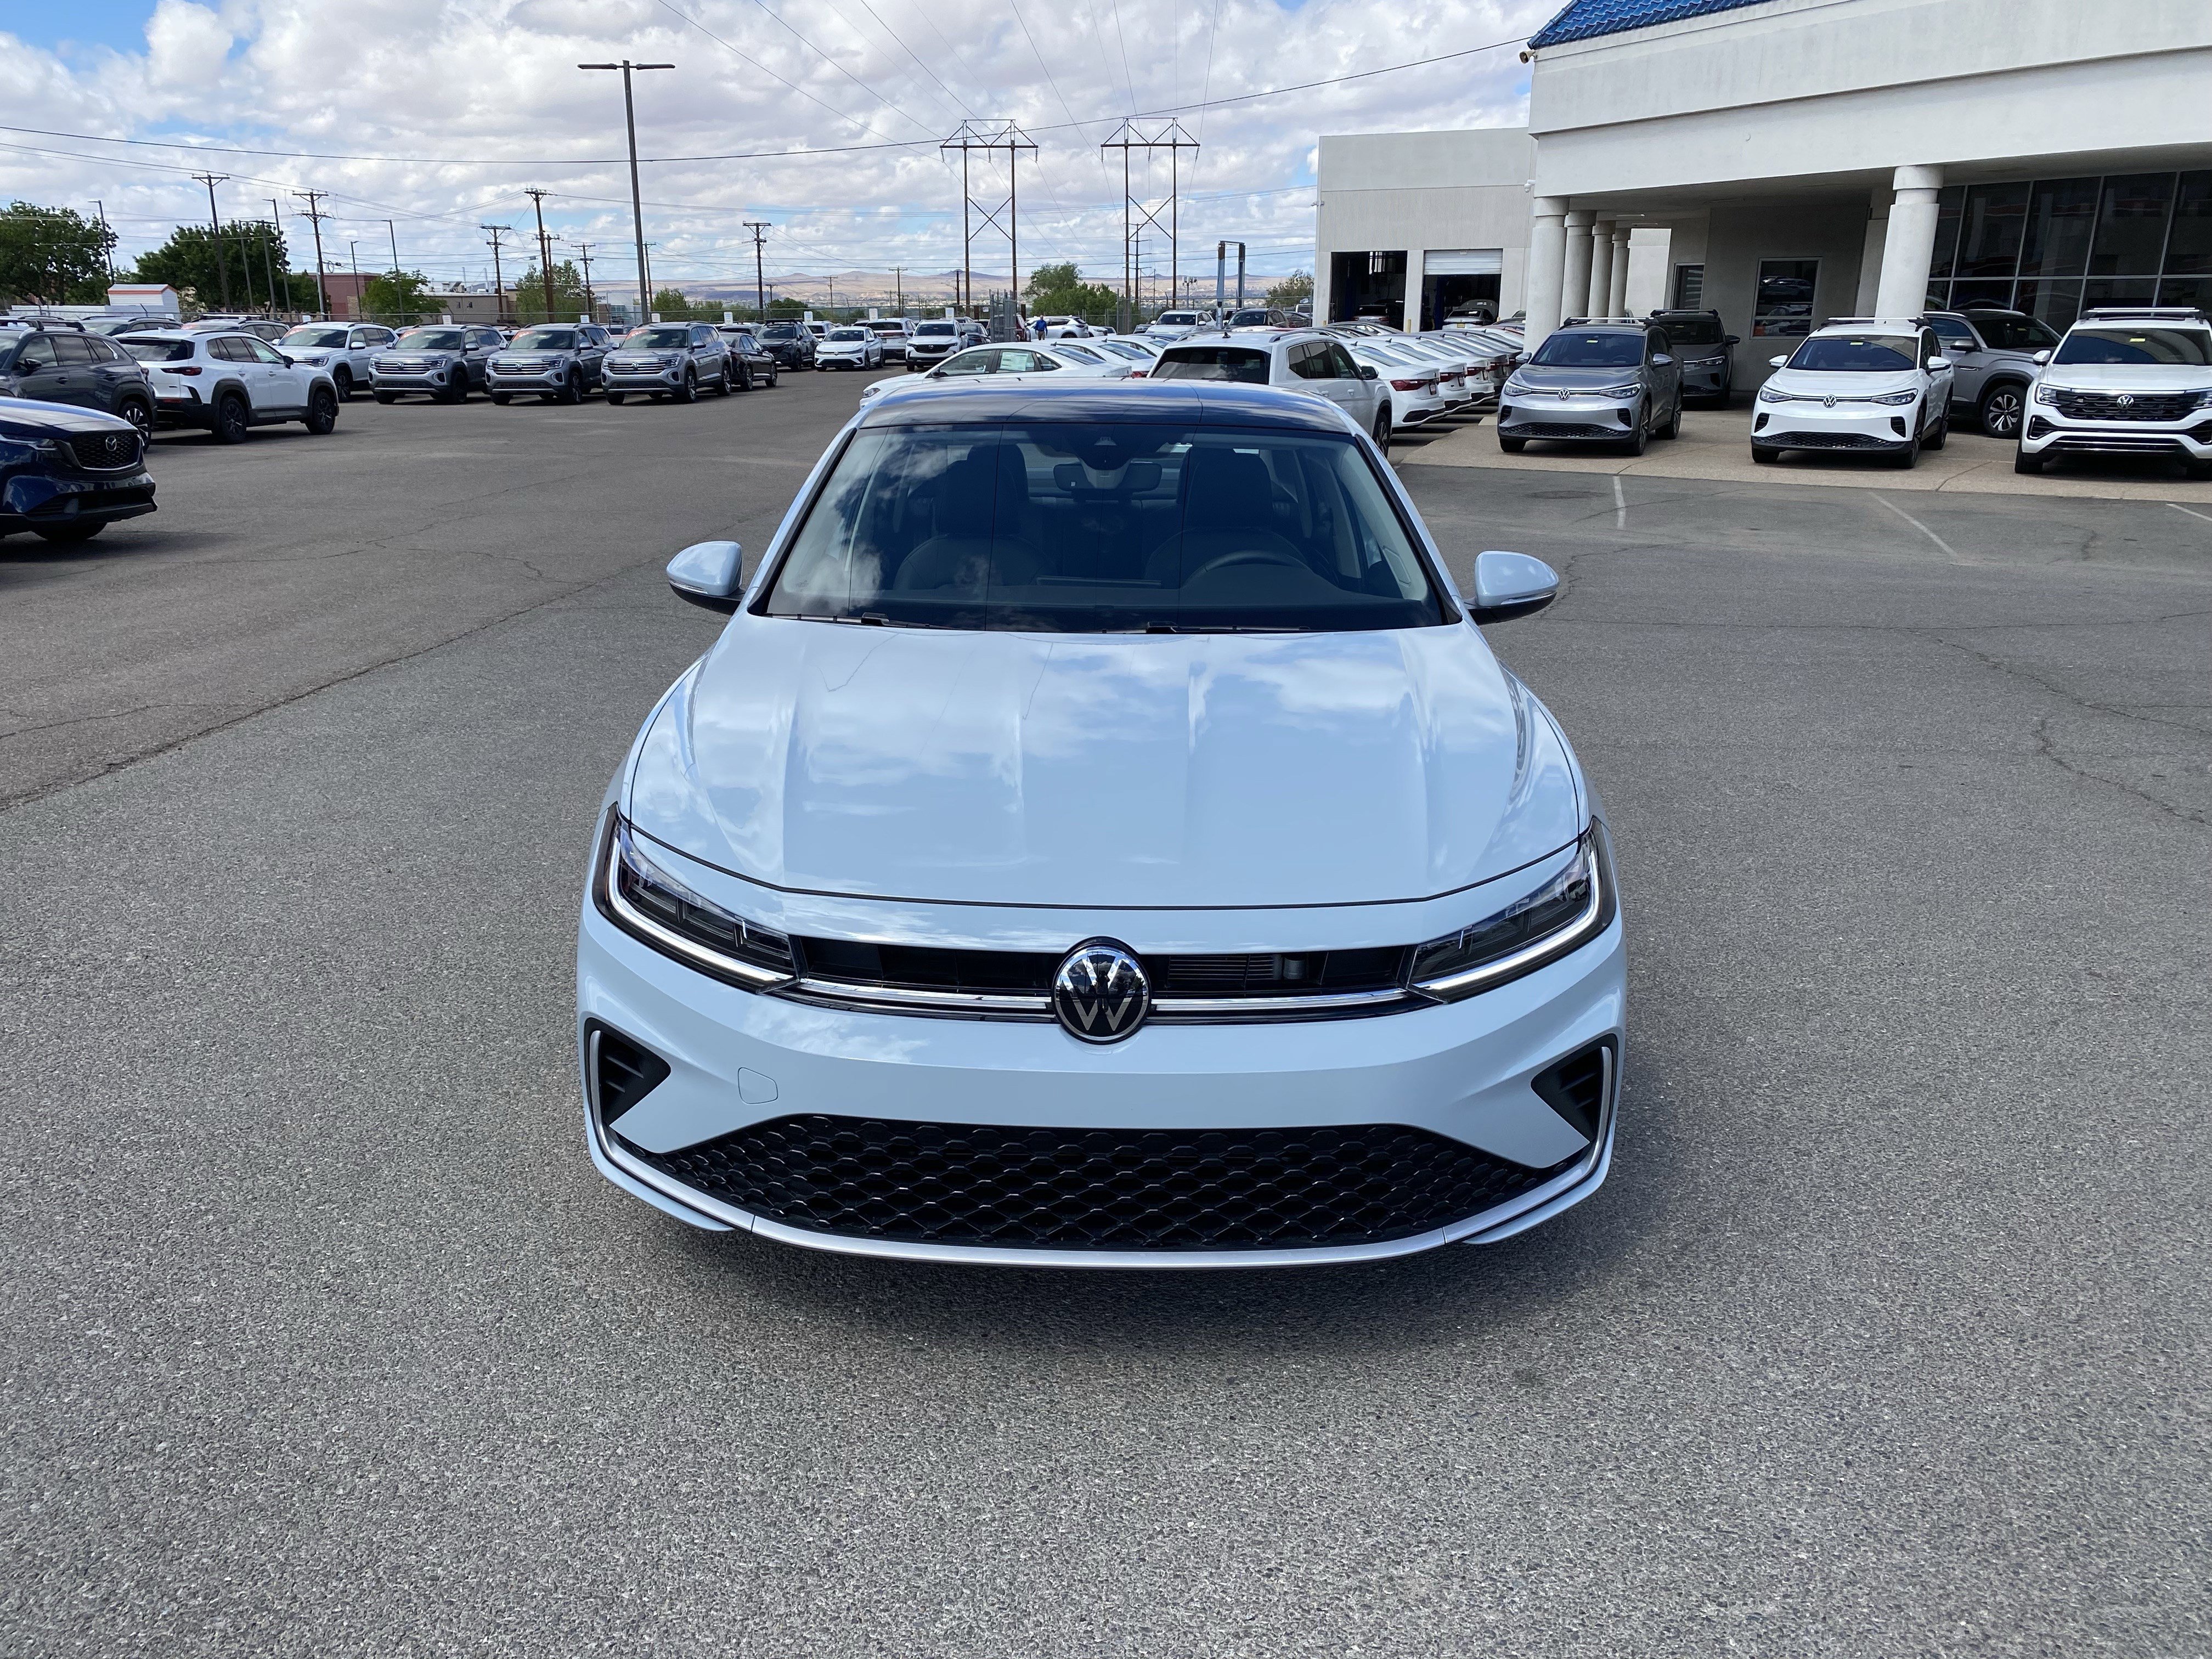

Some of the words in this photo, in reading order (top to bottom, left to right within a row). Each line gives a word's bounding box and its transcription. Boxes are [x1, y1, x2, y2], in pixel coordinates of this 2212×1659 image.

[1558, 388, 1570, 400] VW
[1823, 394, 1837, 408] VW
[1056, 946, 1148, 1040] VW
